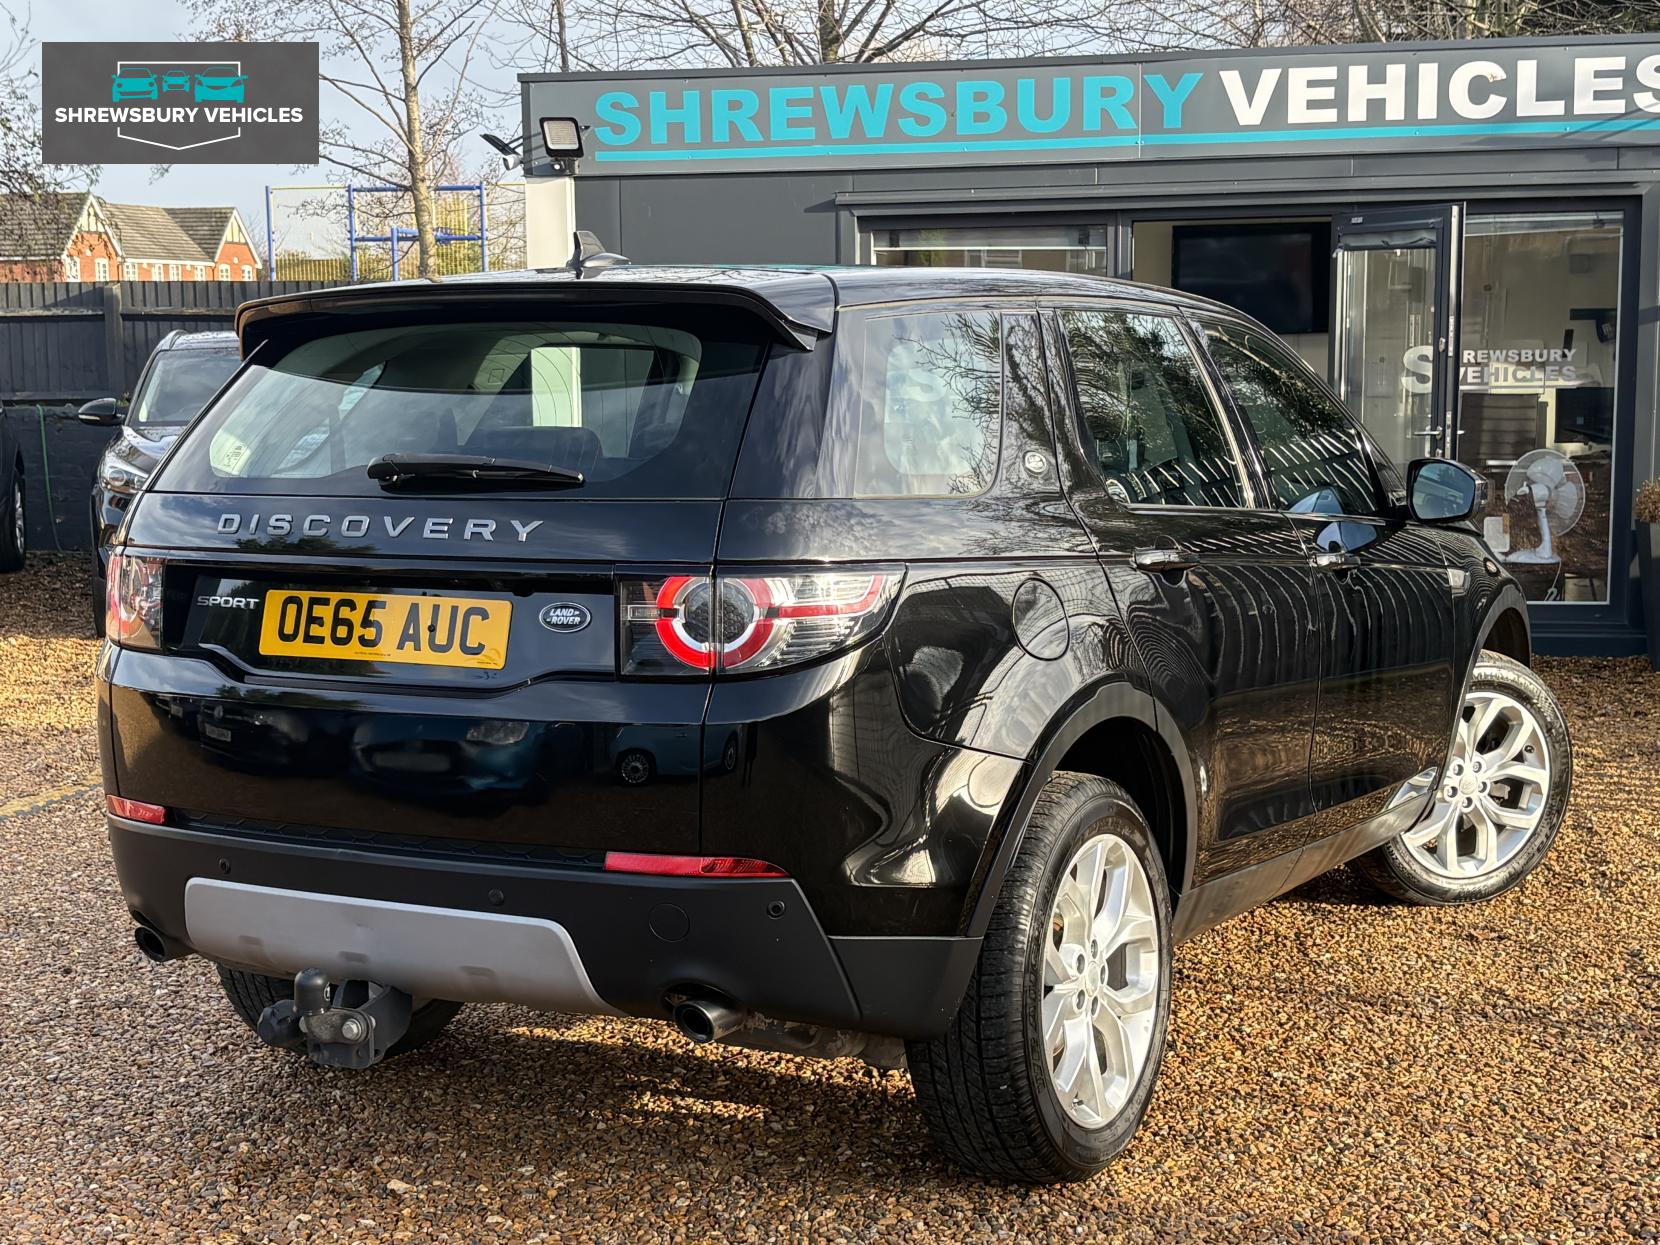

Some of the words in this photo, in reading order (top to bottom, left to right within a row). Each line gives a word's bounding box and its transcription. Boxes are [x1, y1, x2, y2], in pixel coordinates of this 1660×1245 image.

[594, 73, 1204, 146] SHREWSBURY
[1463, 349, 1576, 363] REWSBURY
[217, 513, 544, 542] DISCOVERY
[197, 596, 259, 609] SPORT
[550, 608, 574, 617] LAND
[278, 595, 387, 648] OE65
[396, 602, 490, 656] AUC
[551, 616, 580, 625] ROVER
